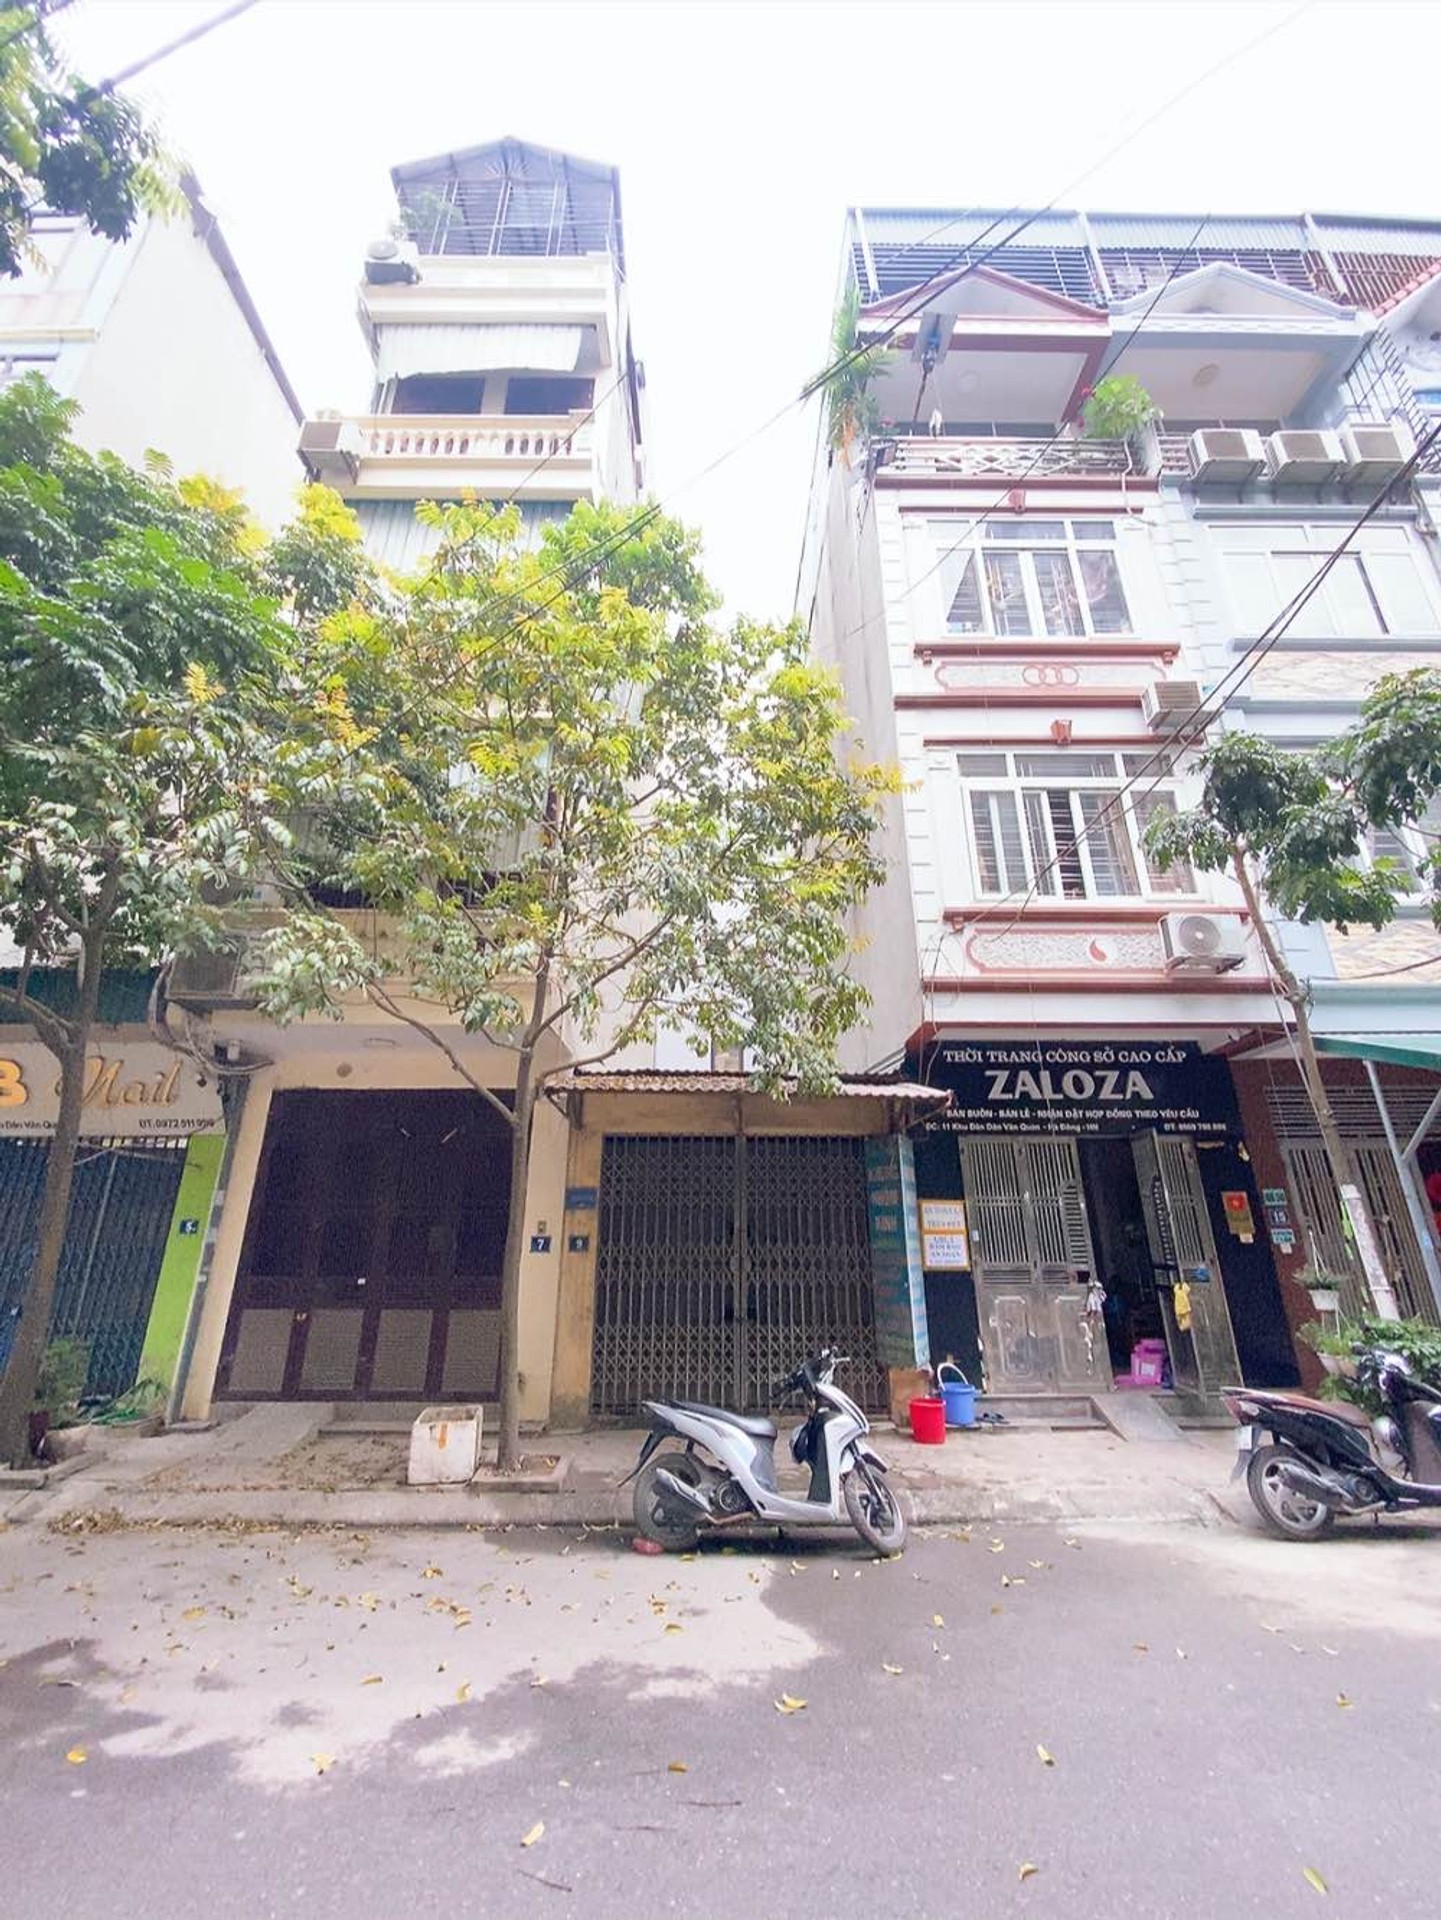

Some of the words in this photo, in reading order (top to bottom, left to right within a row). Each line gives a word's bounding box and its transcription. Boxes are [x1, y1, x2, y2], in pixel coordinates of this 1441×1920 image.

[943, 1046, 983, 1063] THỜI
[986, 1050, 1042, 1063] TRANG
[1046, 1047, 1091, 1063] CÔNG
[1093, 1045, 1115, 1063] SỞ
[1118, 1050, 1151, 1063] CAO
[1155, 1041, 1187, 1063] CẤP
[984, 1069, 1155, 1100] ZALOZA
[537, 1238, 545, 1251] 7
